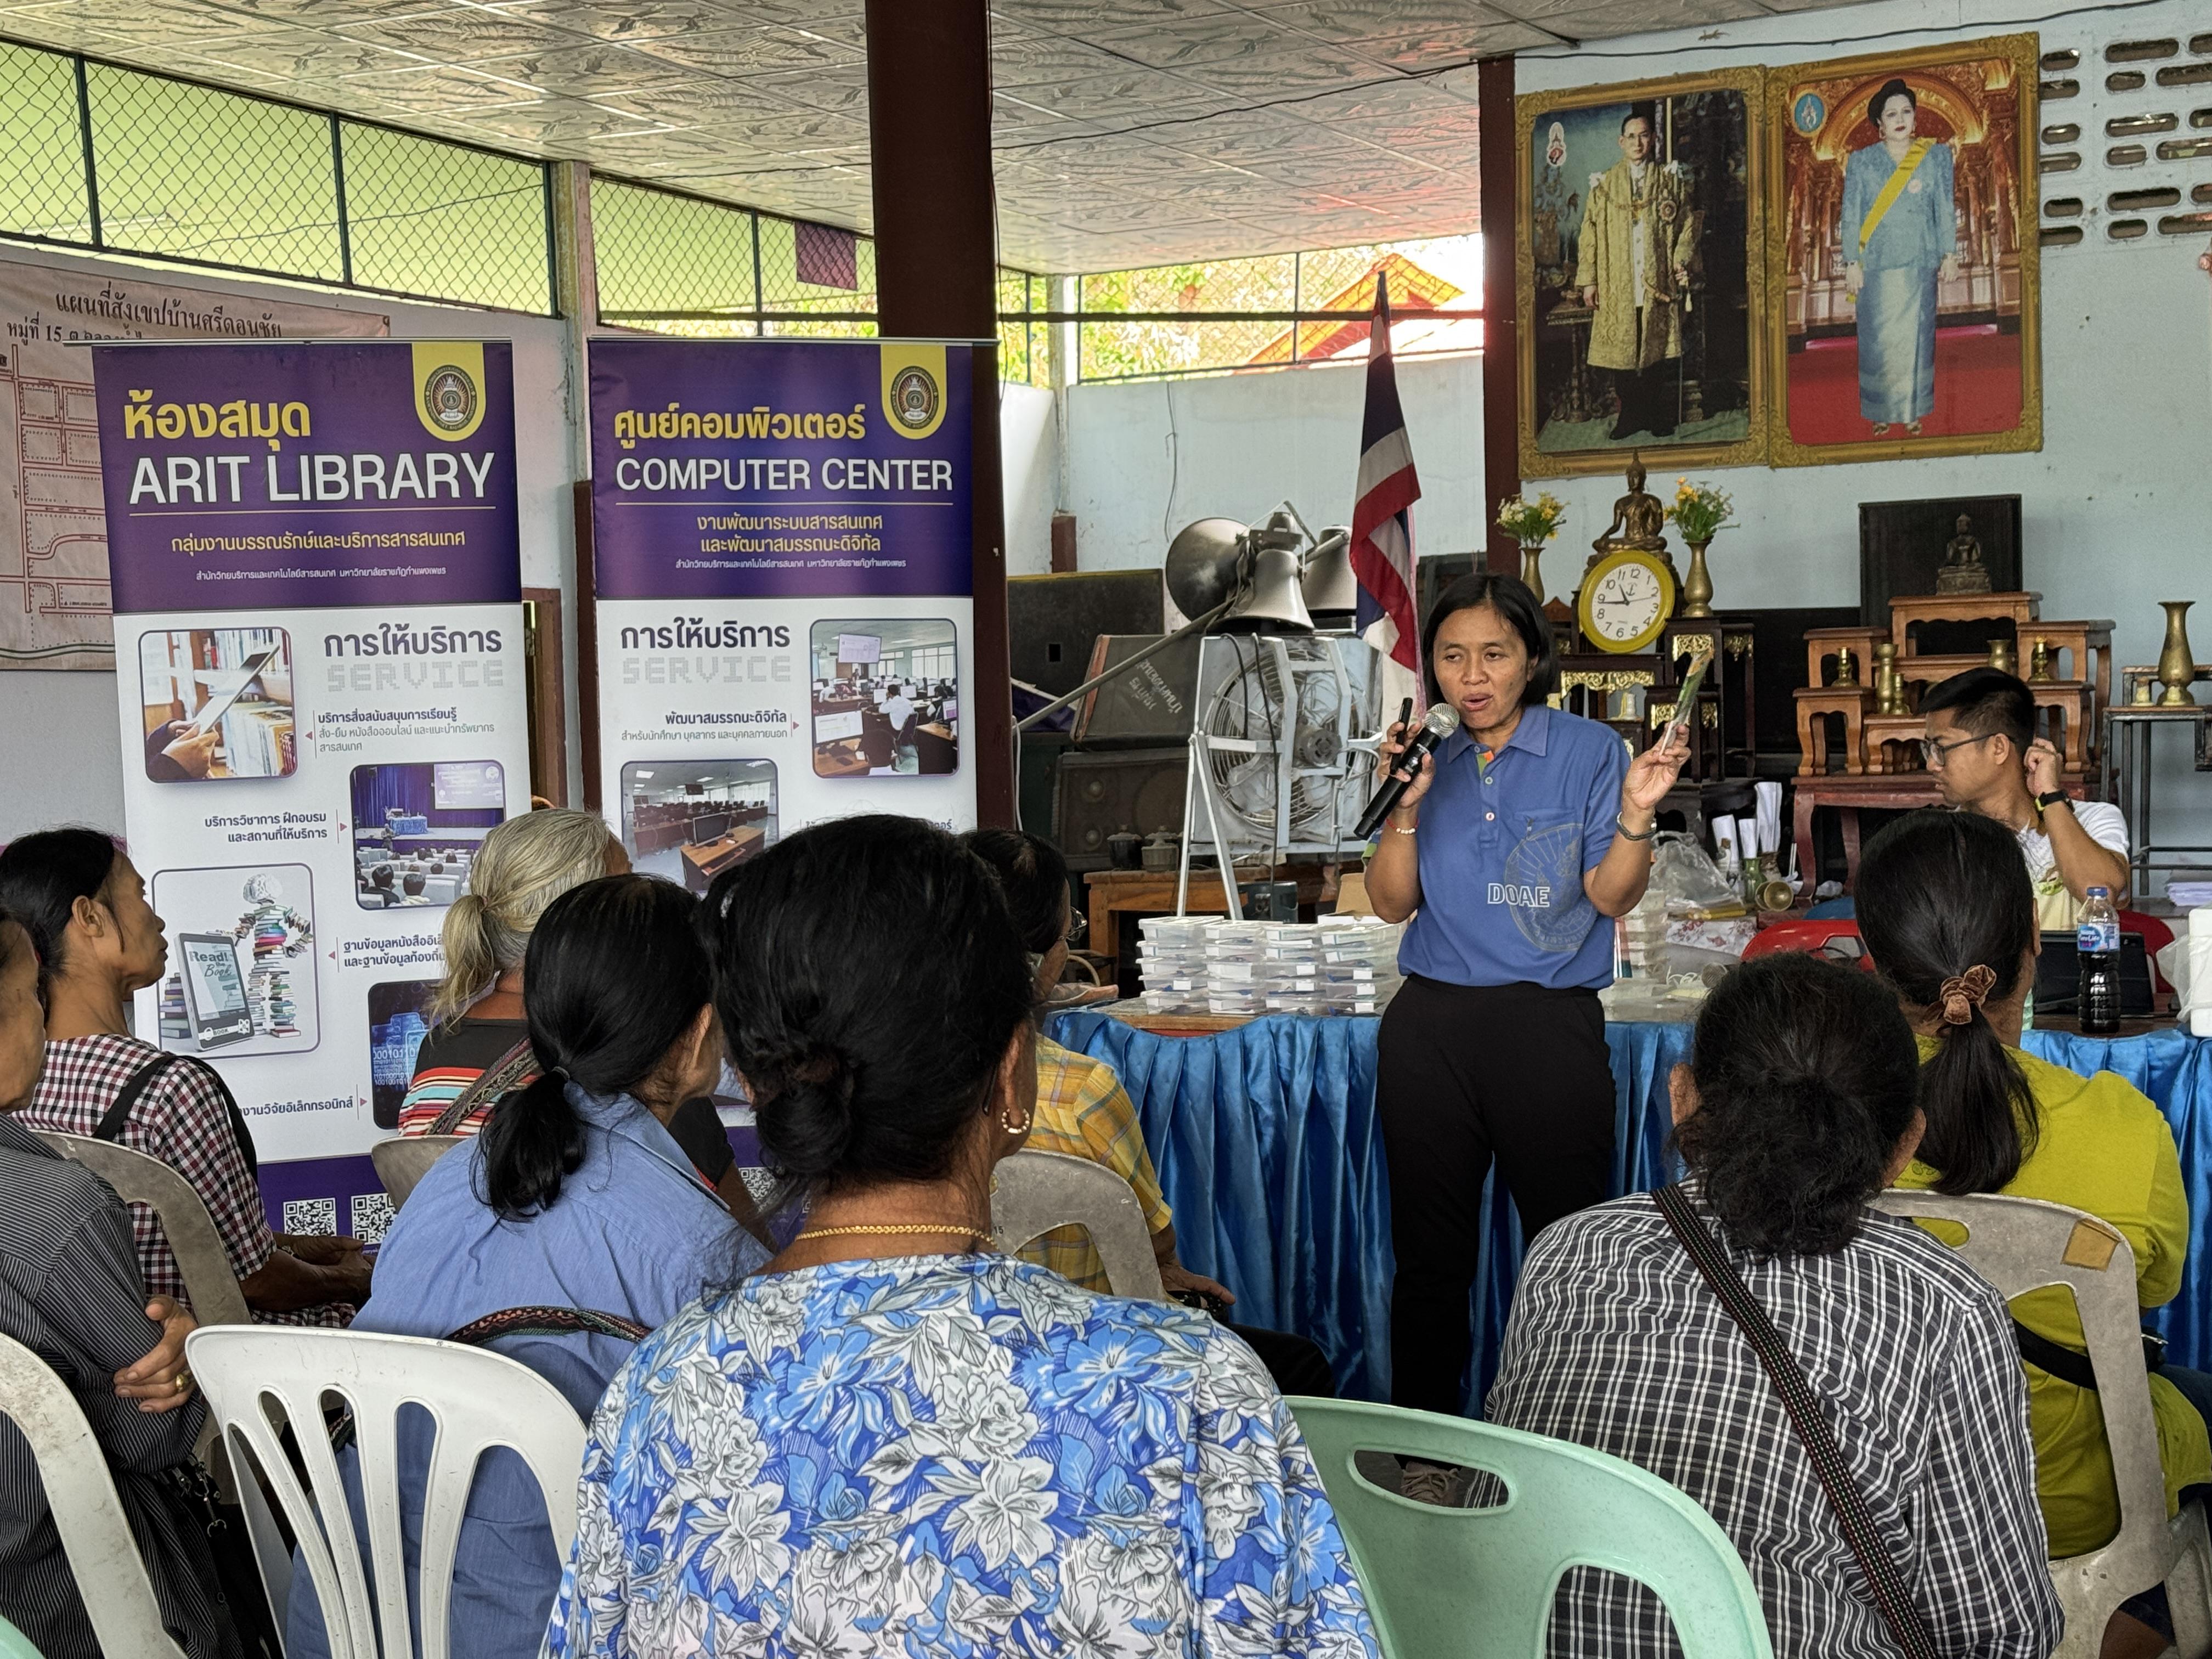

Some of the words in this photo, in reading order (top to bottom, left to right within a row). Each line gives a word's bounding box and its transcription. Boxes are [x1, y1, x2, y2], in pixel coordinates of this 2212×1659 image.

[7, 312, 40, 346] หมู่ที่
[46, 324, 62, 342] 15
[124, 389, 311, 450] ห้องสมุด
[614, 402, 866, 449] ศูนย์คอมพิวเตอร์
[129, 455, 250, 504] ARIT
[267, 452, 495, 502] LIBRARY
[616, 458, 811, 490] COMPUTER
[822, 459, 953, 491] CENTER
[697, 512, 883, 530] งานพัฒนาระบบสารสนเทศ
[172, 531, 466, 556] กลุ่มงานบรรณรักษ์และบริการสารสนเทศ
[701, 533, 881, 552] และพัฒนาสมรรถนะดิจิทัล
[1618, 569, 1626, 580] 11
[1630, 568, 1641, 579] 12
[1646, 574, 1651, 585] 1
[1605, 579, 1616, 590] 10
[1651, 586, 1659, 597] 2
[1598, 594, 1606, 604] 9
[1597, 608, 1605, 619] 8
[1650, 603, 1659, 613] 3
[1605, 622, 1612, 631] 7
[1643, 616, 1651, 627] 4
[621, 617, 791, 649] การให้บริการ
[1616, 628, 1624, 637] 6
[1630, 626, 1639, 636] 5
[325, 623, 502, 657] การให้บริการ
[327, 660, 504, 692] SERVICE
[623, 656, 791, 684] SERVICE
[318, 707, 458, 724] บริการสิ่งสนับสนุนการเรียนรู้
[665, 709, 787, 724] พัฒนาสมรรถนะดิจิทัล
[205, 814, 280, 827] บริการวิชาการ
[228, 825, 328, 843] และสถานที่ให้บริการ
[1487, 882, 1550, 907] DOAE
